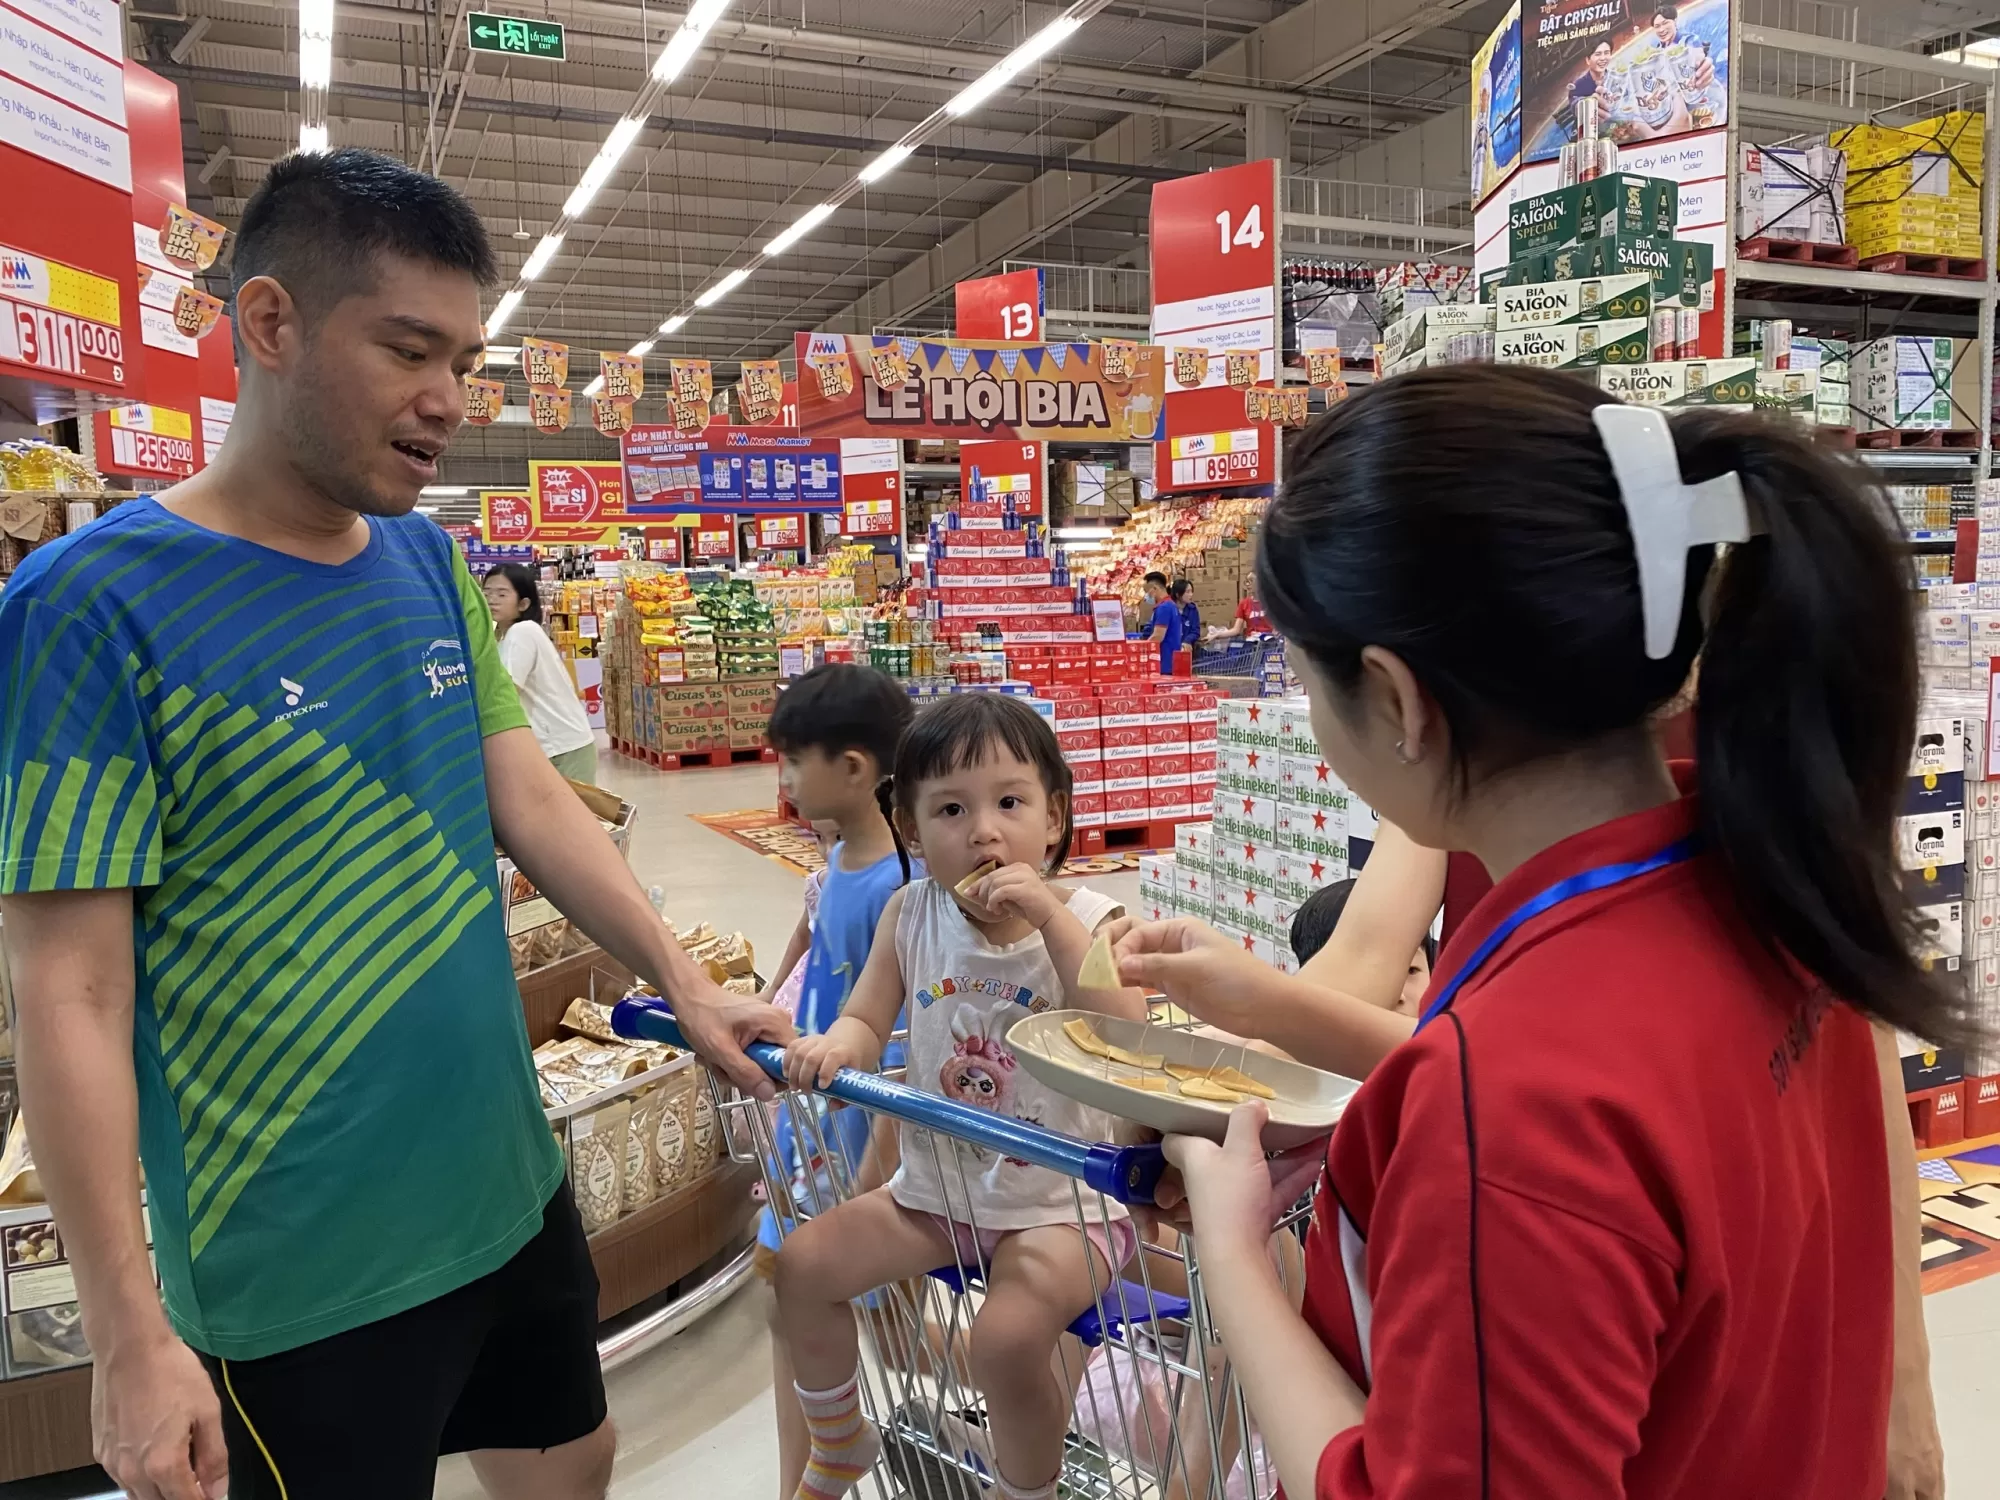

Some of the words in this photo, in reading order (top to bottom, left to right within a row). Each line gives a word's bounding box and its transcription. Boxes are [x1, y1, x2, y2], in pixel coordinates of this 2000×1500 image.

[1563, 1, 1621, 27] CRYSTAL!
[1537, 33, 1553, 48] TIỆC
[1553, 31, 1569, 44] NHÀ
[1634, 157, 1657, 173] Cây
[1678, 148, 1704, 163] Men
[1682, 161, 1703, 172] Cider
[1529, 196, 1546, 210] BIA
[1679, 194, 1704, 209] Men
[1510, 201, 1565, 230] SAIGON
[1681, 207, 1703, 218] Cider
[1216, 204, 1265, 254] 14
[1516, 220, 1560, 241] SPECIAL
[1635, 239, 1652, 249] BIA
[164, 245, 197, 262] BIA
[1618, 247, 1669, 267] SAIGON
[1526, 287, 1546, 297] BIA
[1504, 294, 1568, 313] SAIGON
[1000, 302, 1034, 340] 13
[1437, 311, 1468, 319] SAIGON
[1510, 310, 1562, 323] LAGER
[175, 318, 200, 332] BIA
[1524, 331, 1543, 342] BIA
[1502, 338, 1566, 357] SAIGON
[1507, 353, 1560, 365] LAGER
[1105, 366, 1125, 375] BIA
[1630, 367, 1651, 377] BIA
[531, 374, 554, 384] BIA
[1311, 377, 1330, 385] BIA
[1607, 375, 1674, 391] SAIGON
[608, 386, 631, 397] BIA
[824, 385, 845, 397] BIA
[863, 360, 923, 422] LỄ
[931, 369, 1018, 428] HỘI
[1026, 380, 1109, 424] BIA
[680, 393, 701, 403] BIA
[751, 393, 772, 403] BIA
[782, 404, 797, 427] 11
[535, 417, 558, 427] BIA
[695, 441, 709, 451] MM
[1021, 445, 1035, 460] 13
[885, 477, 896, 489] 12
[723, 514, 731, 523] 10
[664, 690, 705, 702] Custas
[732, 686, 771, 698] Custas
[910, 697, 942, 705] PAULAN
[1107, 715, 1141, 726] Budweiser
[1150, 712, 1185, 724] Budweiser
[667, 724, 707, 735] Custas
[1061, 719, 1096, 730] Budweiser
[1229, 727, 1278, 749] Heineken
[1109, 747, 1143, 758] Budweiser
[1152, 743, 1186, 755] Budweiser
[1293, 738, 1321, 756] Hein
[1915, 746, 1946, 760] Corona
[1923, 757, 1940, 766] Extra
[1111, 778, 1144, 789] Budweiser
[1154, 775, 1187, 786] Budweiser
[1229, 773, 1278, 796] Heineken
[1112, 809, 1145, 821] Budweiser
[1155, 806, 1188, 817] Budweiser
[1224, 817, 1273, 844] Heineken
[1291, 834, 1348, 861] Heineken
[1915, 839, 1945, 853] Corona
[1923, 850, 1940, 859] Extra
[1176, 852, 1212, 874] Heineken
[1226, 862, 1274, 890] Heineken
[1140, 884, 1174, 906] Heineken
[1176, 895, 1212, 917] Heineken
[1227, 906, 1275, 936] Heineken
[916, 976, 970, 1010] BABY
[985, 978, 1058, 1015] THRE
